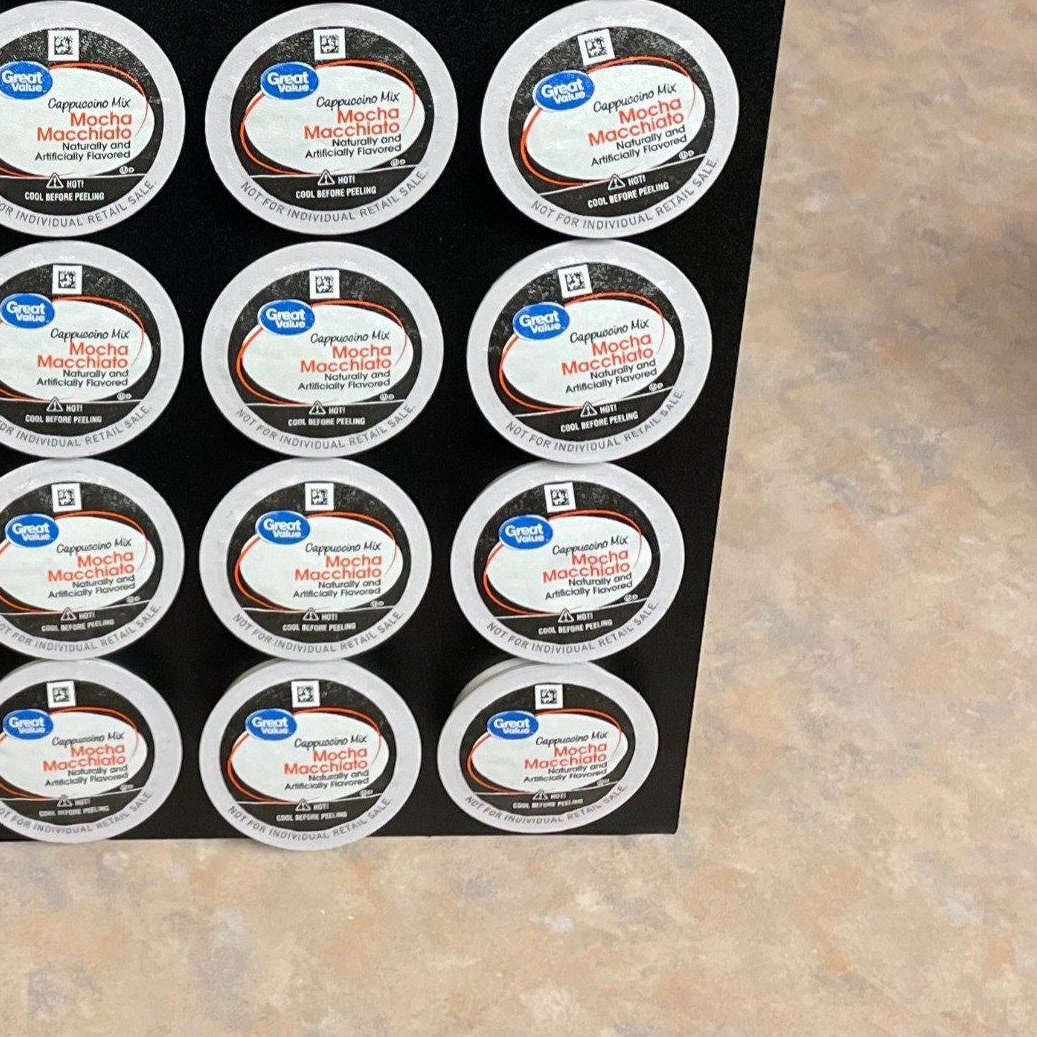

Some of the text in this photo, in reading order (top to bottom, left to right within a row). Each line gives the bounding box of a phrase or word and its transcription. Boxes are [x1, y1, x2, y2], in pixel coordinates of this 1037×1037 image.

[2, 70, 42, 85] Great
[267, 71, 309, 86] Great
[11, 83, 42, 92] Value
[277, 84, 309, 93] Value
[541, 78, 584, 98] Great
[552, 91, 585, 104] Value
[337, 107, 399, 124] Mocha
[618, 98, 682, 124] Mocha
[70, 112, 132, 126] Mocha
[37, 127, 132, 141] Macchiato
[304, 121, 400, 140] Macchiato
[587, 113, 684, 147] Macchiato
[6, 301, 46, 315] Great
[266, 308, 305, 321] Great
[15, 313, 45, 322] Value
[274, 320, 305, 328] Value
[519, 310, 560, 327] Great
[529, 322, 561, 333] Value
[69, 342, 128, 356] Mocha
[332, 344, 392, 358] Mocha
[591, 334, 652, 356] Mocha
[37, 355, 128, 369] Macchiato
[300, 358, 392, 373] Macchiato
[562, 348, 654, 376] Macchiato
[288, 417, 365, 427] COOL BEFORE PEELING
[12, 522, 50, 535] Great
[263, 518, 301, 532] Great
[505, 523, 543, 537] Great
[21, 533, 50, 541] Value
[272, 530, 301, 538] Value
[514, 534, 544, 543] Value
[552, 536, 628, 557] Cappuccino Mix
[77, 552, 134, 567] Mocha
[325, 554, 382, 567] Mocha
[571, 550, 630, 567] Mocha
[48, 564, 135, 582] Macchiato
[295, 567, 382, 581] Macchiato
[542, 561, 631, 583] Macchiato
[569, 572, 632, 588] Naturally and
[545, 581, 634, 599] Artificially Flavored
[8, 717, 45, 729] Great
[252, 717, 288, 729] Great
[494, 718, 530, 729] Great
[260, 727, 288, 735] Value
[70, 744, 125, 757] Mocha
[312, 748, 369, 761] Mocha
[553, 744, 608, 756] Mocha
[43, 755, 126, 771] Macchiato
[284, 760, 369, 774] Macchiato
[525, 754, 608, 769] Macchiato
